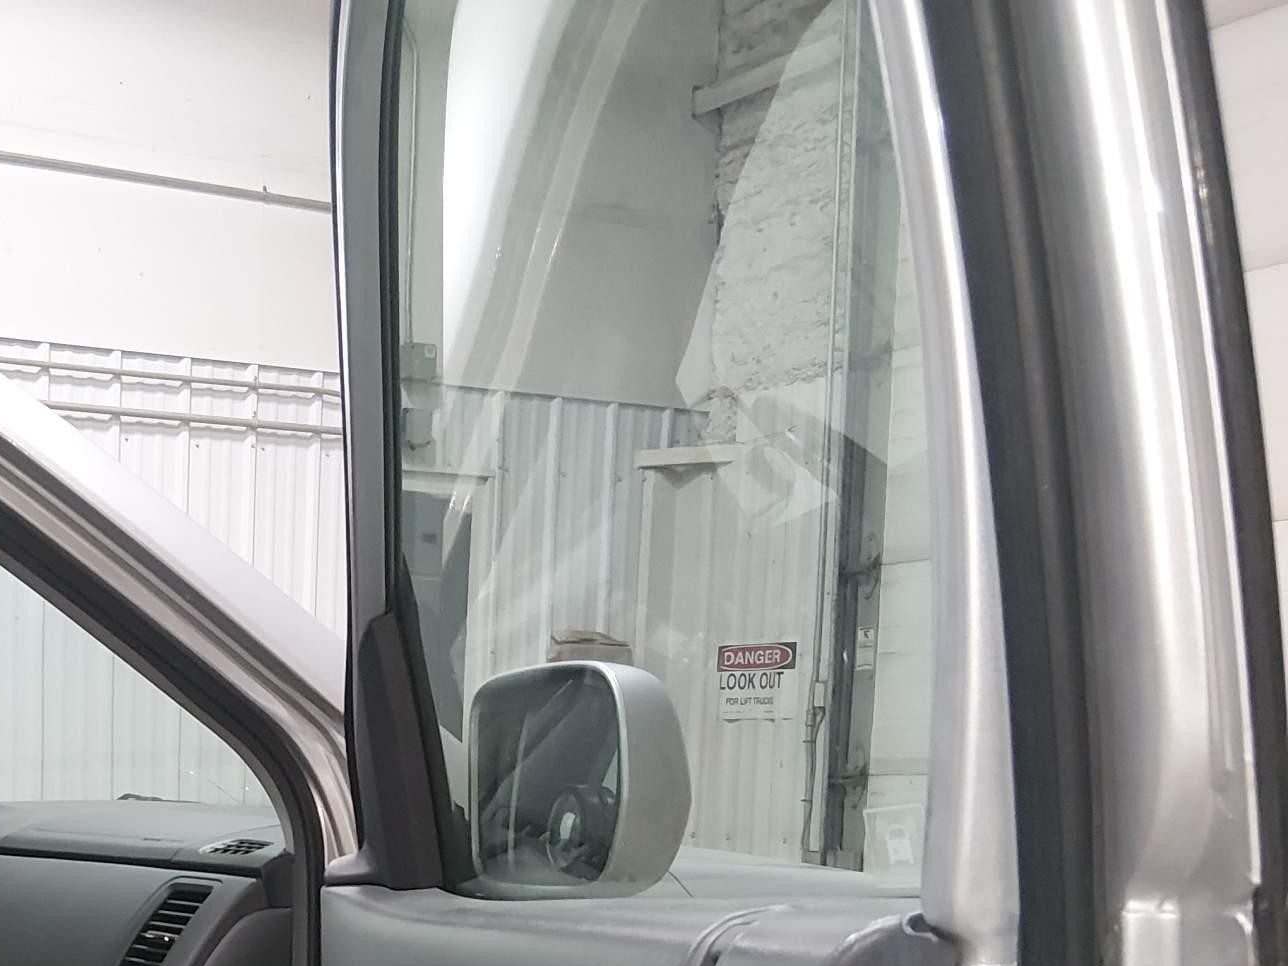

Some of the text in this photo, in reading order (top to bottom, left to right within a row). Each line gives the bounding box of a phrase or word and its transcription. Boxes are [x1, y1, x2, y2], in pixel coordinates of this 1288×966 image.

[724, 649, 781, 665] DANGER
[720, 671, 785, 691] LOOK OUT
[726, 697, 739, 705] FOR
